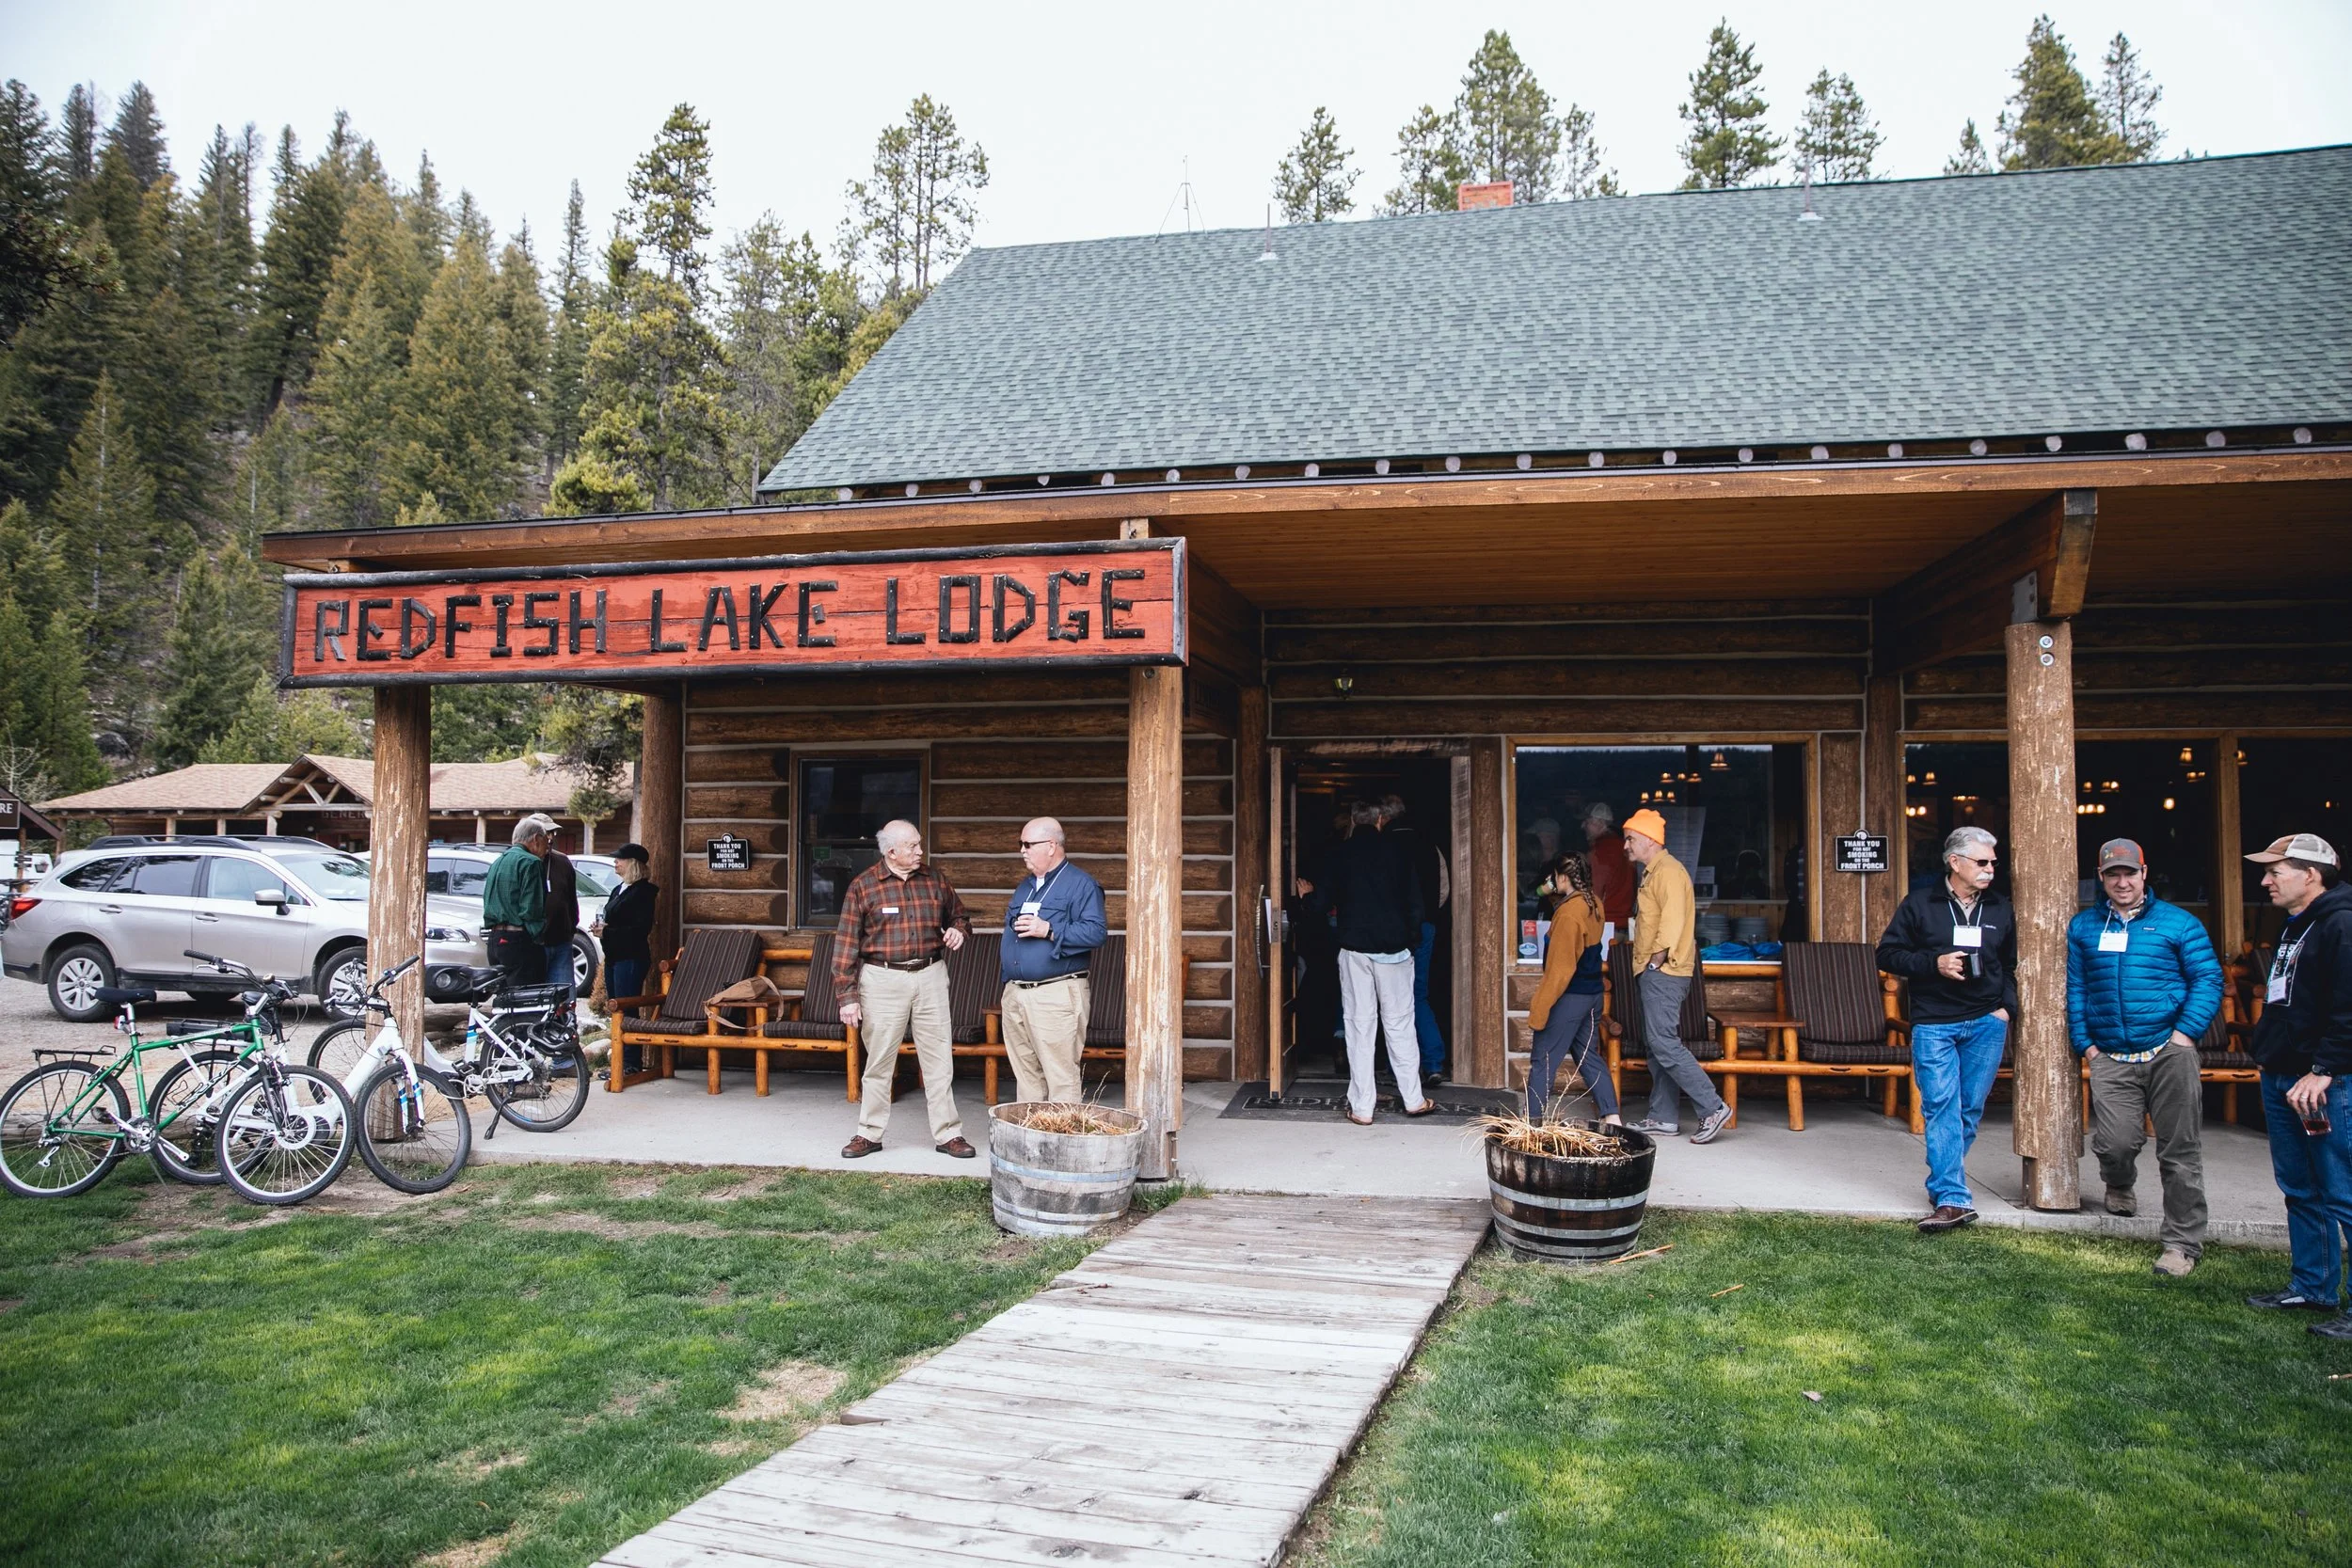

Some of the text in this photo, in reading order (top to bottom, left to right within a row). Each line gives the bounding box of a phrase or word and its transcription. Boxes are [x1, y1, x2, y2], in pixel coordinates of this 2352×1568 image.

[314, 568, 1145, 661] REDFISH LAKE LODGE
[322, 810, 366, 819] GENER
